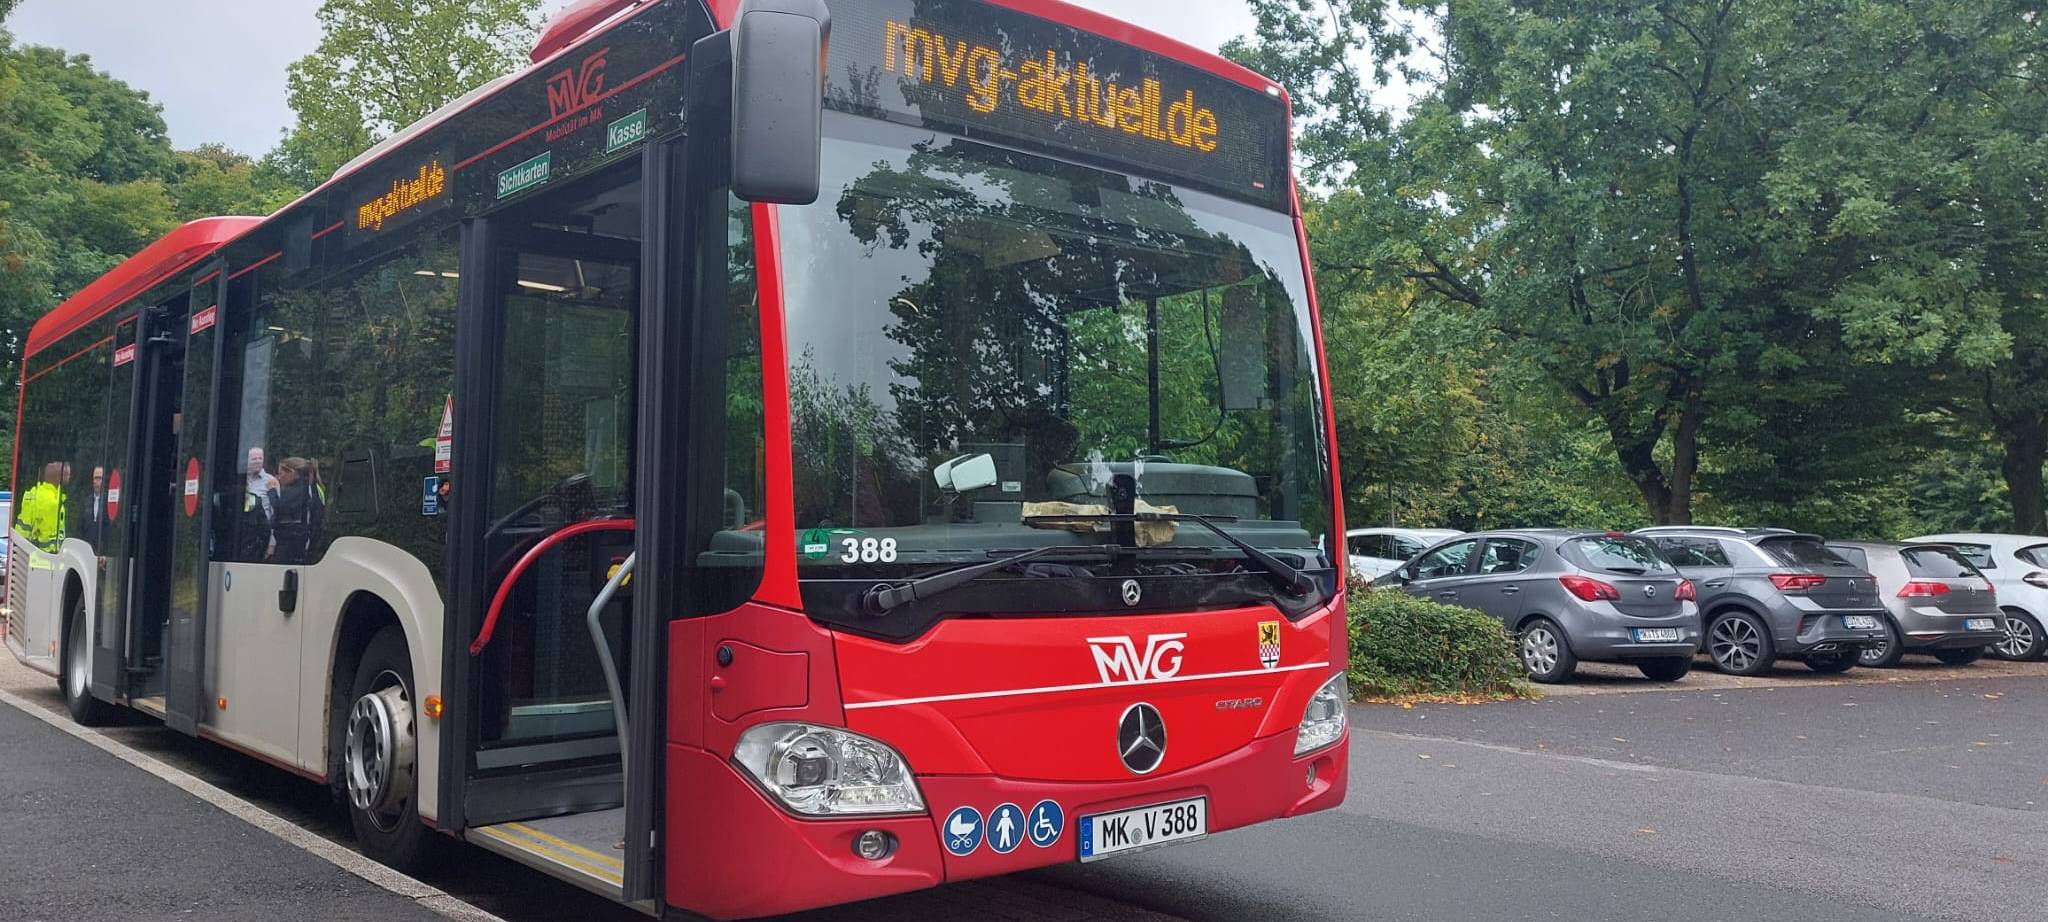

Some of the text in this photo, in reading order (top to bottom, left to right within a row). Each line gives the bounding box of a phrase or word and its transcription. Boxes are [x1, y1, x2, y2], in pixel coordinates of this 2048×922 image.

[545, 47, 610, 120] MVG
[884, 17, 1219, 153] mvg-aktuell.de
[590, 107, 604, 123] MK
[609, 119, 642, 147] Kasse
[500, 161, 549, 194] Sichtkarten
[811, 529, 820, 542] 4
[841, 537, 897, 564] 388
[1086, 633, 1187, 685] MVG
[1102, 804, 1197, 848] MK V 388
